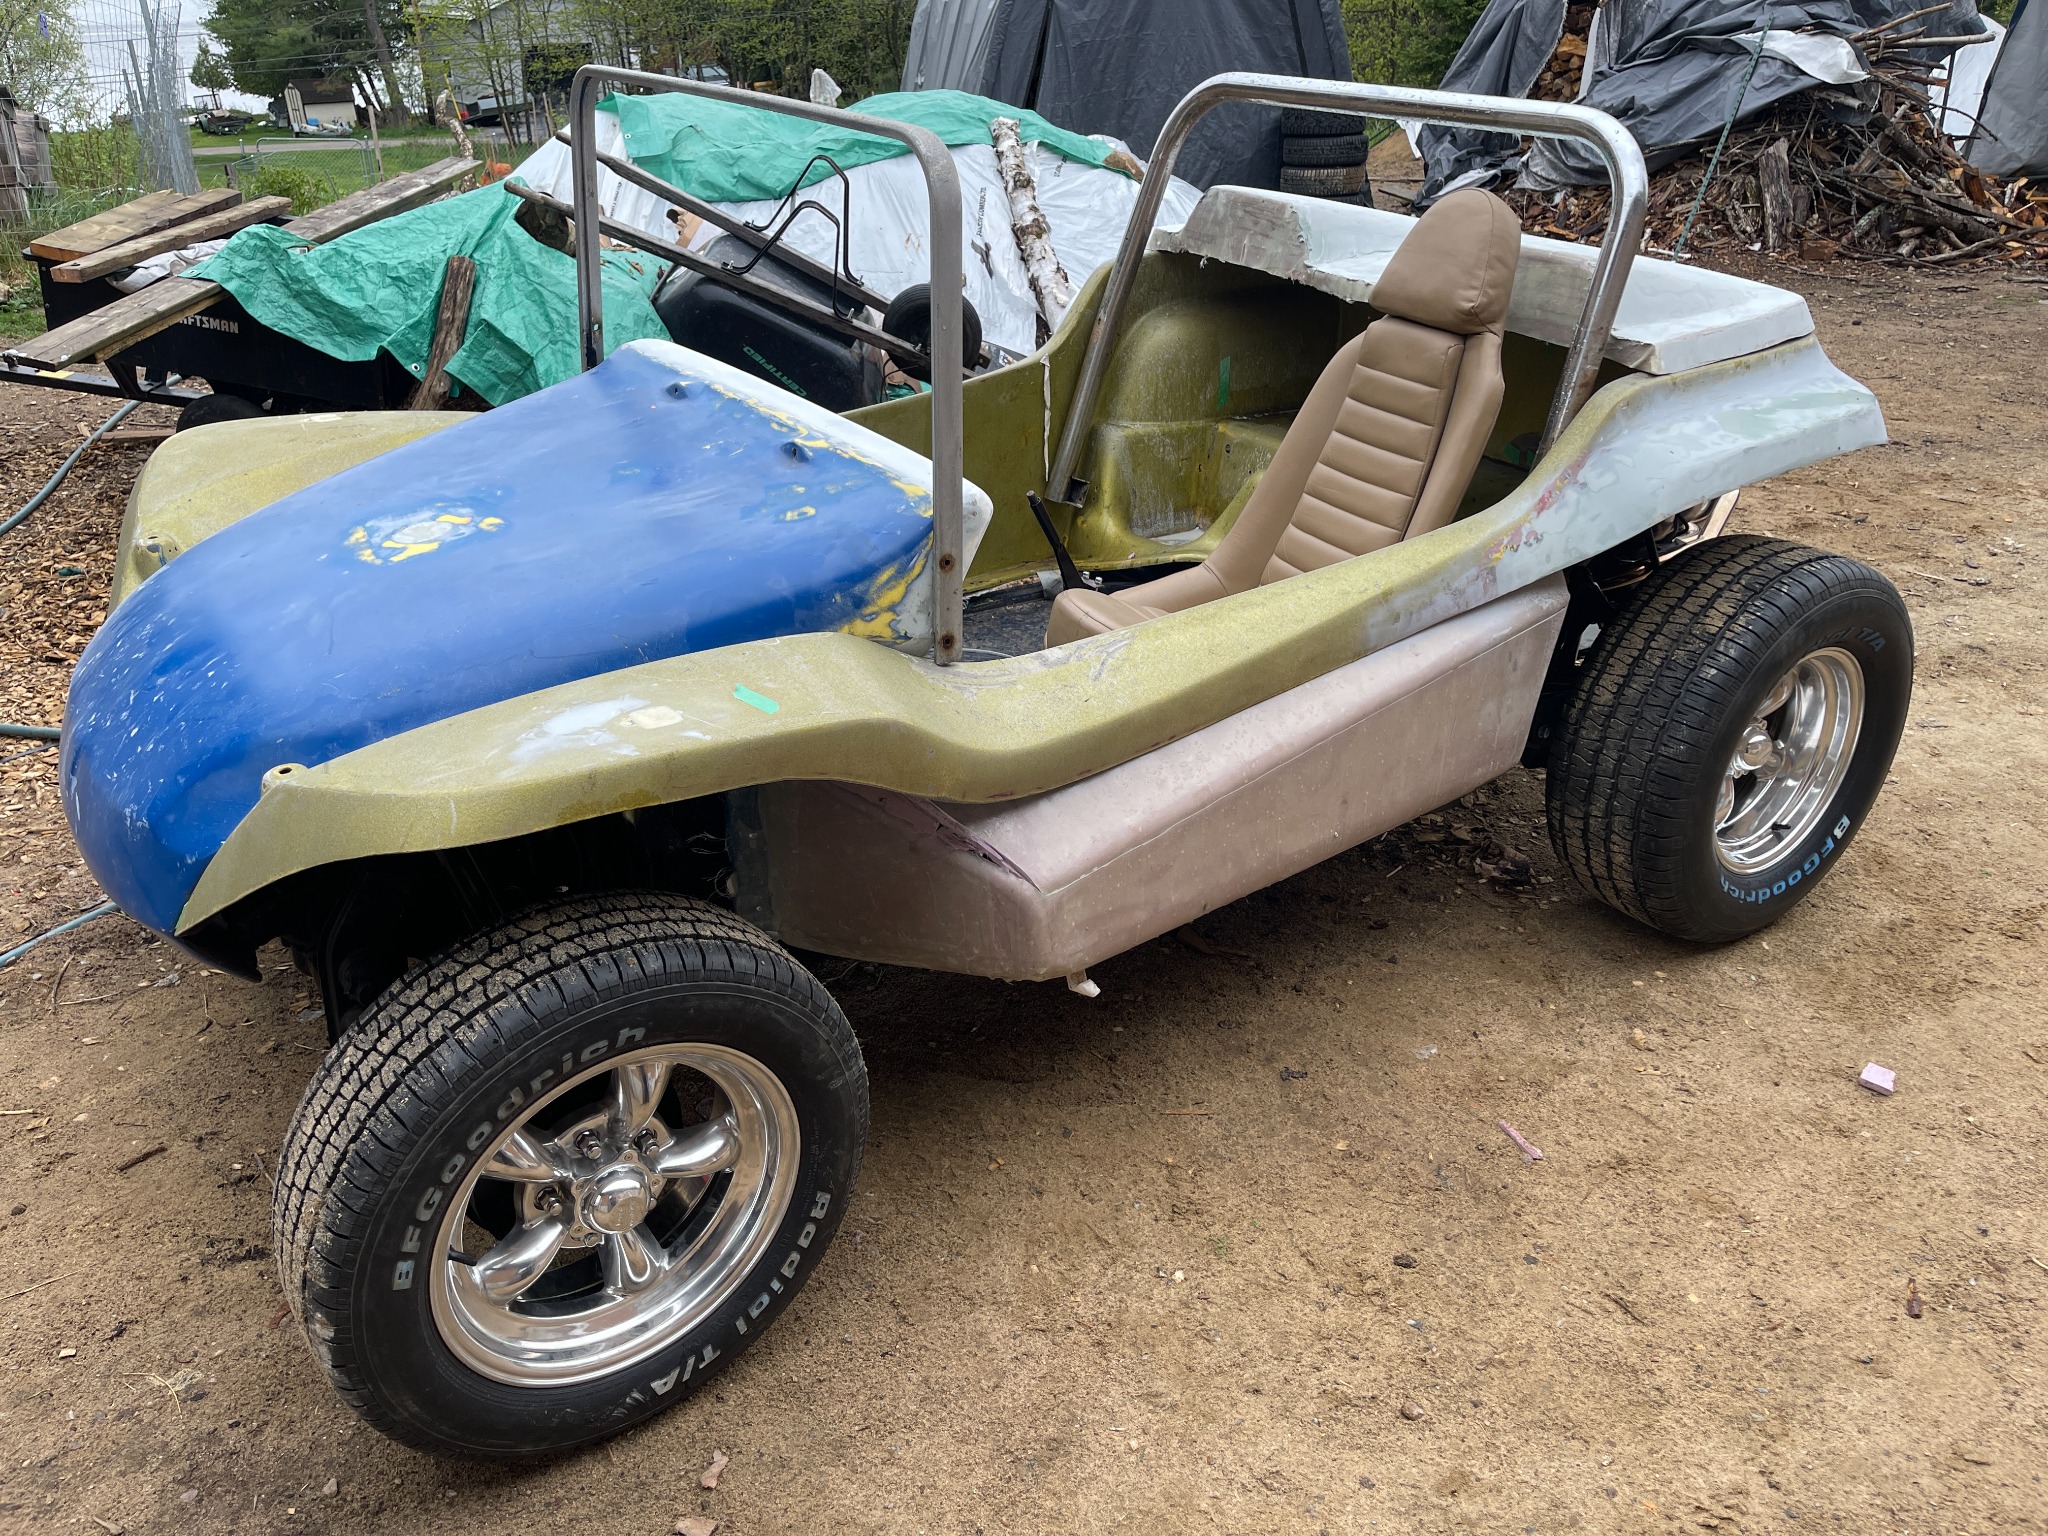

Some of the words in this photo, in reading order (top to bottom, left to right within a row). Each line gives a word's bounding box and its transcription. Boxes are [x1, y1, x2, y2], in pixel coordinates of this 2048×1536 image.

[180, 315, 239, 334] FTSMAN
[742, 346, 808, 397] CERTIFIED
[1857, 627, 1886, 652] T/A
[1720, 814, 1851, 905] BFGoodrich
[392, 1026, 647, 1291] BFGoodrich
[735, 1190, 832, 1335] Radial
[650, 1344, 721, 1396] T/A
